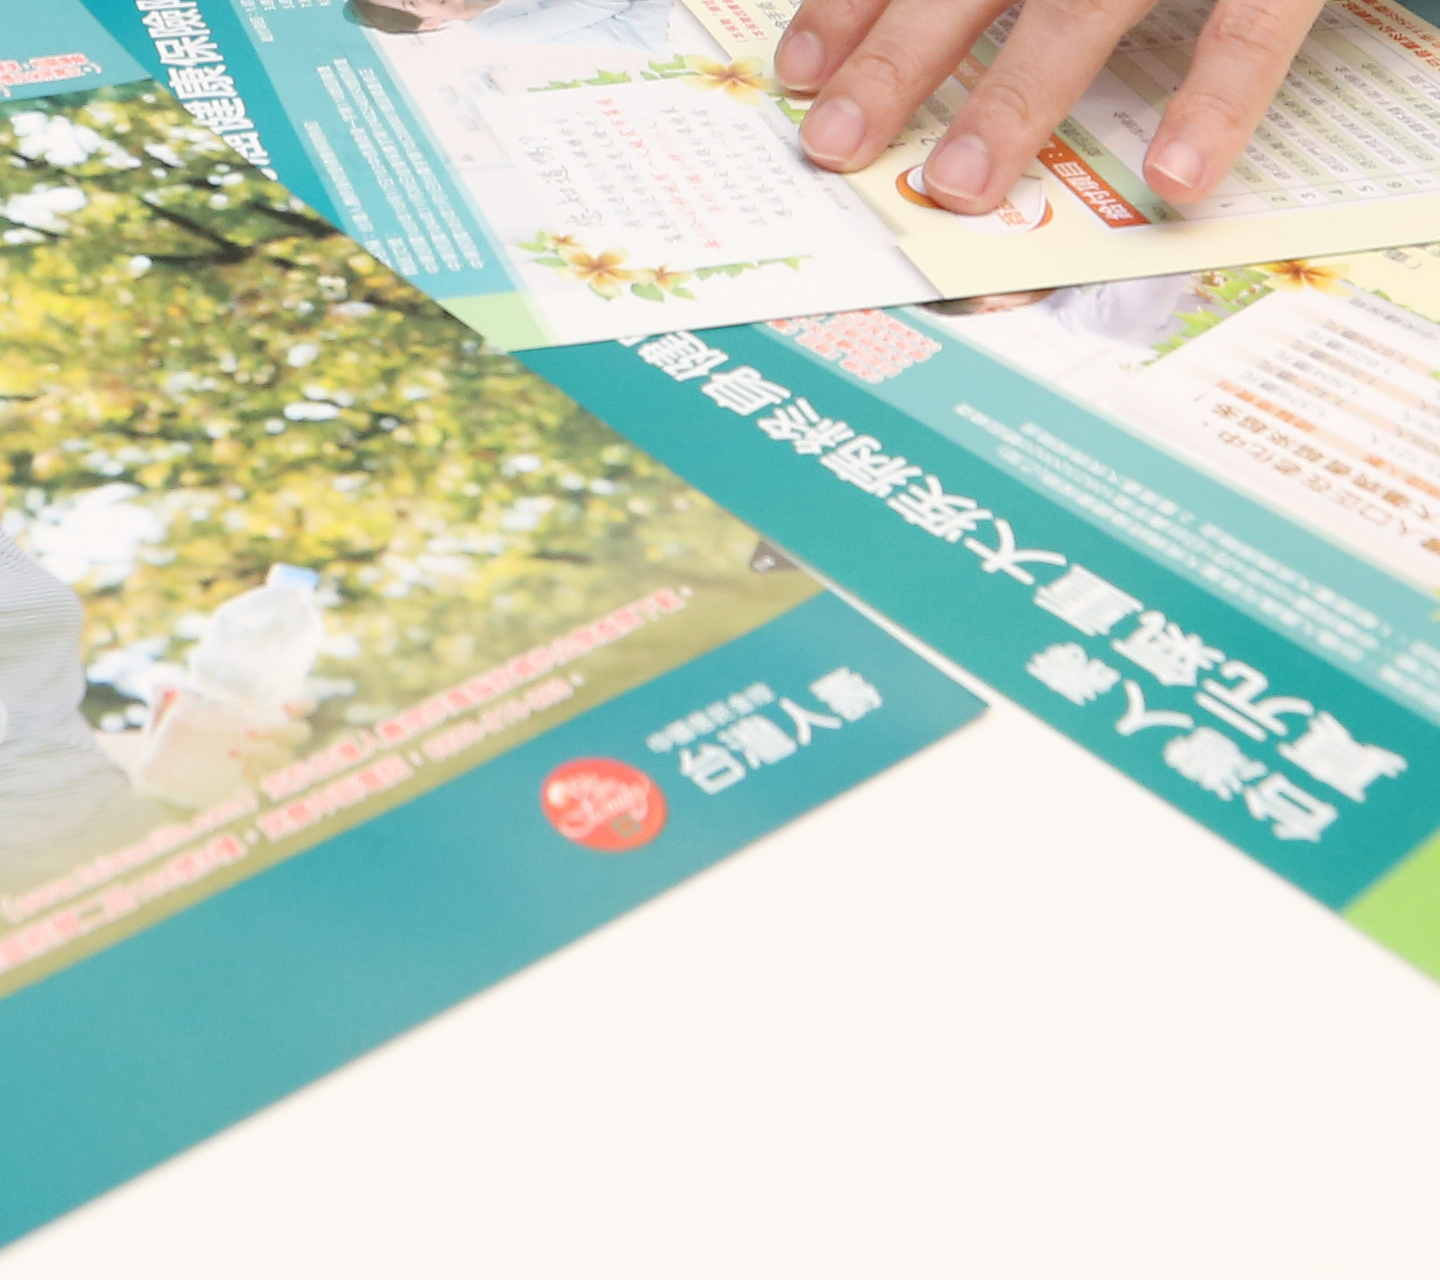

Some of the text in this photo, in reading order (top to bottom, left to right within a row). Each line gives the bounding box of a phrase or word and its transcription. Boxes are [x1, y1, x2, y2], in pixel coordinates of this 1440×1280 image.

[617, 330, 1408, 804] 真元氣重大疾病終身健
[675, 666, 887, 797] 台灣人壽
[1024, 639, 1338, 844] 台灣人壽
